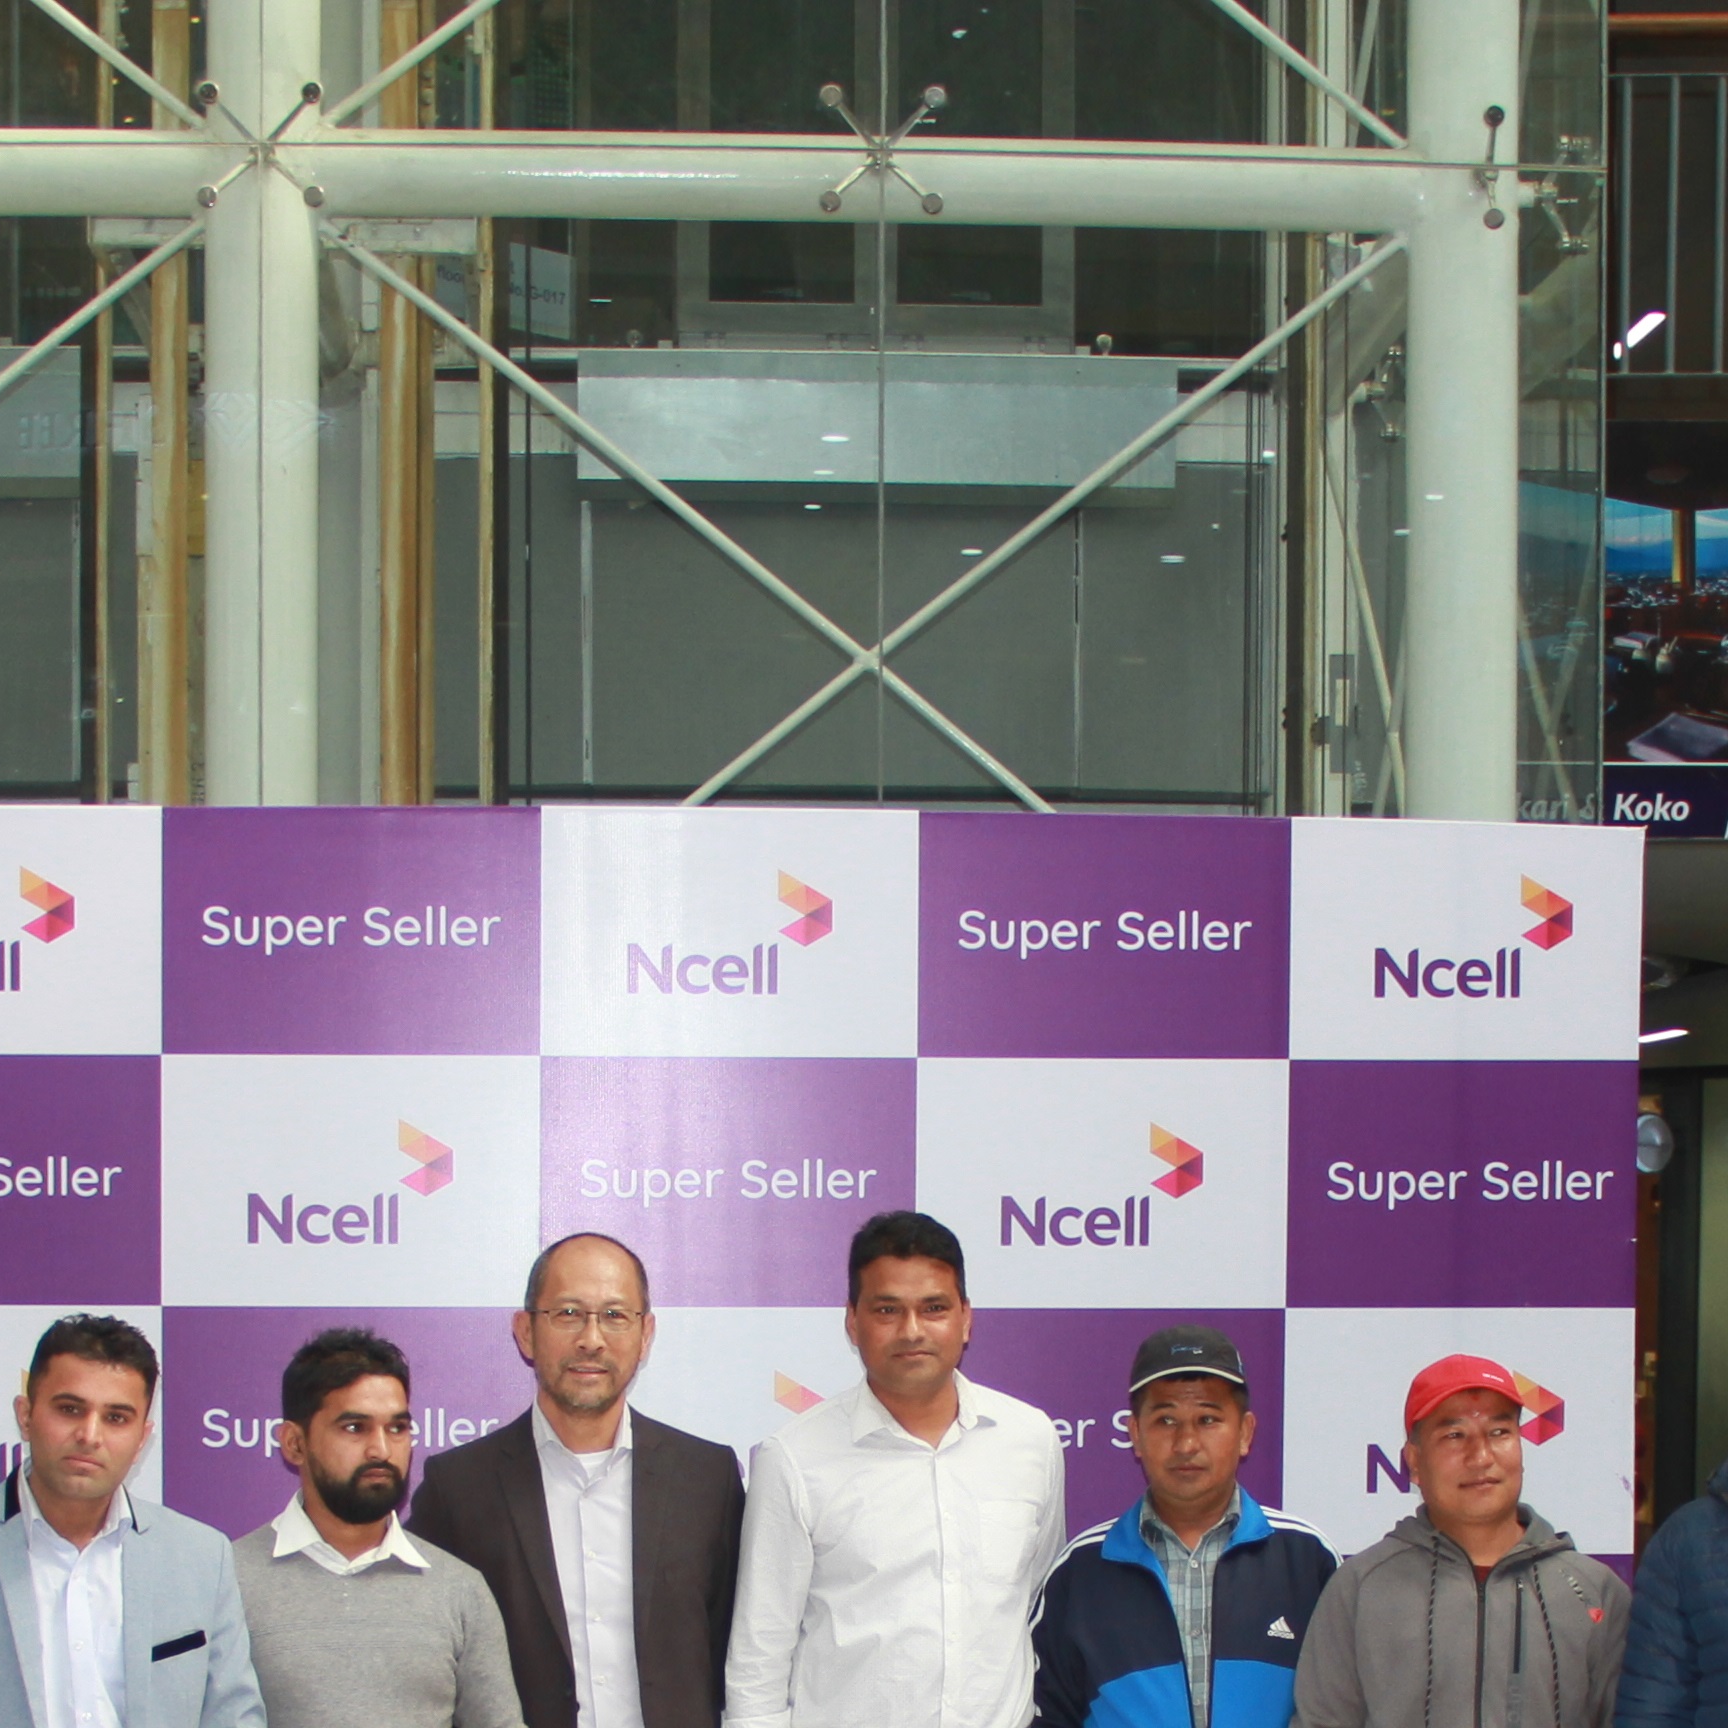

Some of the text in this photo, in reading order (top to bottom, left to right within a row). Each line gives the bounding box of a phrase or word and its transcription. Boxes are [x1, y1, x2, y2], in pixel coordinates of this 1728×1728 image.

[1613, 792, 1690, 822] Koko
[201, 904, 501, 954] Super Seller
[956, 909, 1253, 959] Super Seller
[626, 943, 779, 996] Ncell
[1373, 946, 1521, 999] Ncell
[579, 1157, 878, 1208] Super Seller
[1325, 1160, 1614, 1210] Super Seller
[247, 1193, 400, 1246] Ncell
[999, 1196, 1151, 1248] Ncell
[202, 1408, 284, 1457] Sup
